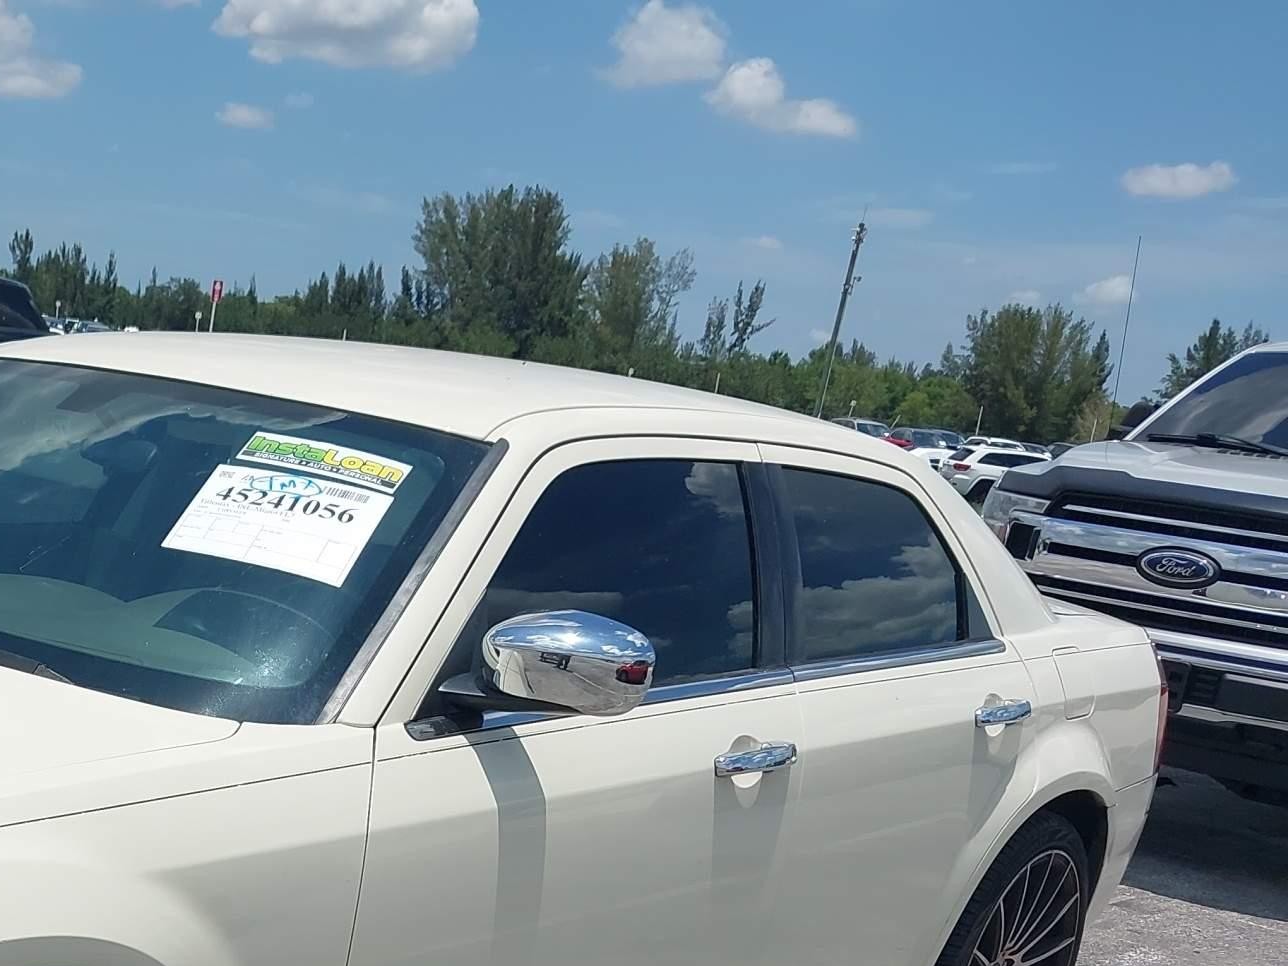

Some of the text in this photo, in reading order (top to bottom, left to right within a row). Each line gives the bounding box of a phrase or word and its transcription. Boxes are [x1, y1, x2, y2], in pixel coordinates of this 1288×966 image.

[247, 436, 404, 483] InstaLoan
[254, 451, 383, 486] SIGNATURE AUTO PERSONAL
[216, 486, 360, 524] 45241056
[1156, 557, 1196, 576] Ford
